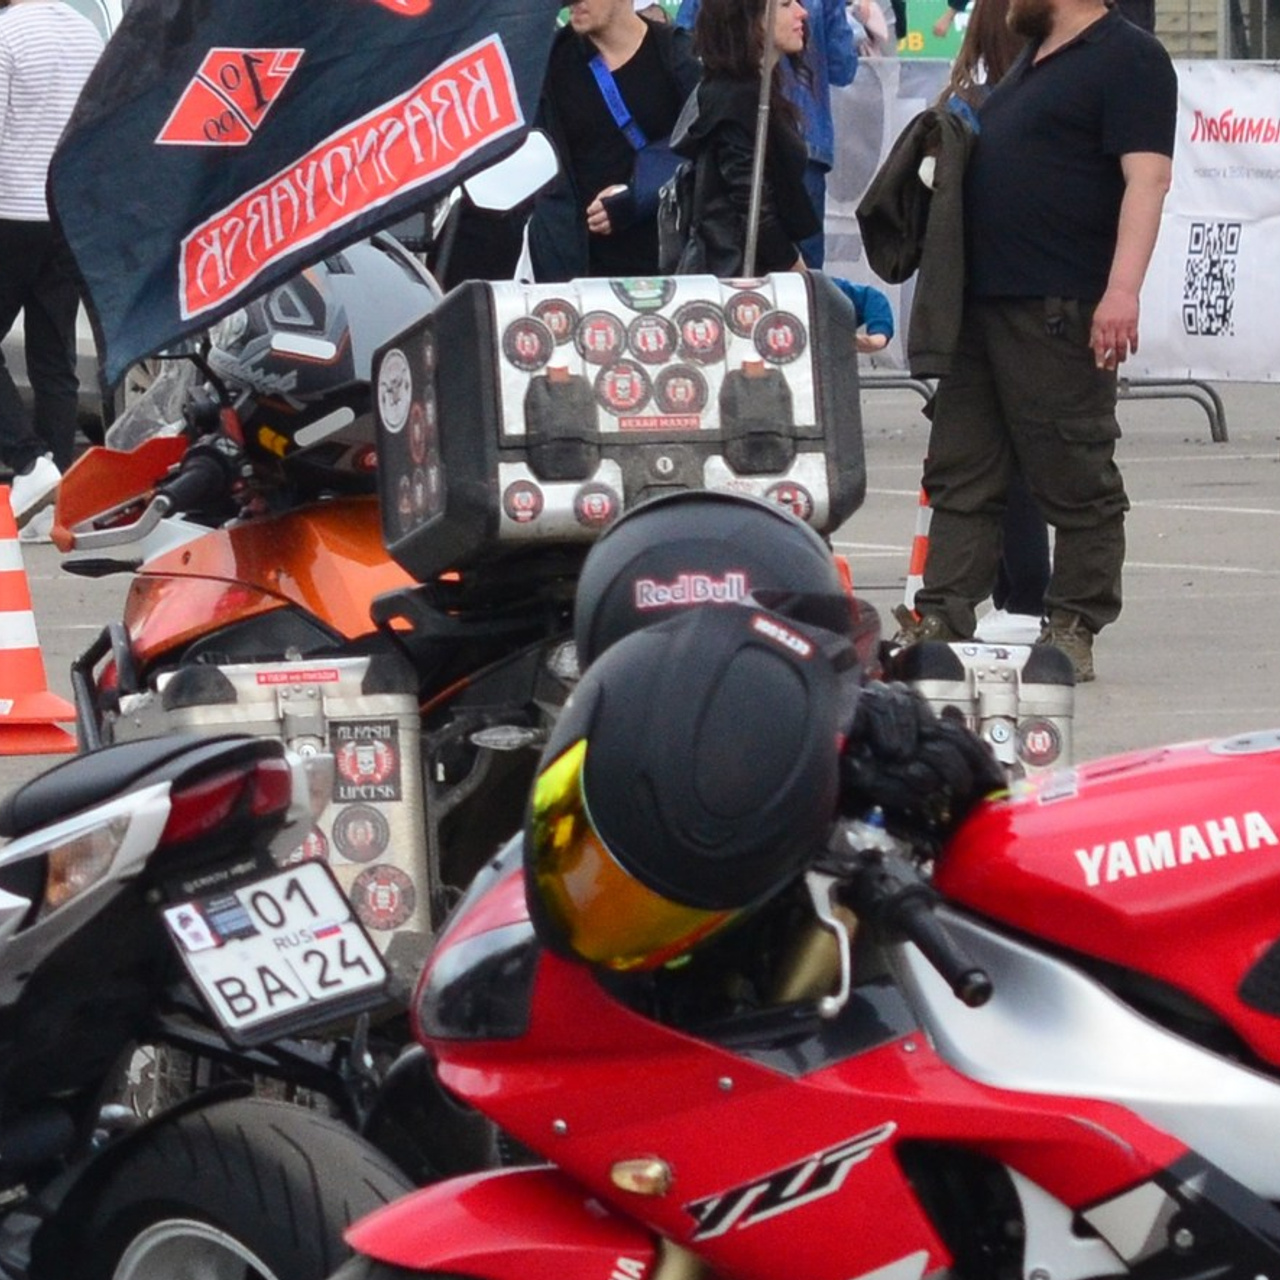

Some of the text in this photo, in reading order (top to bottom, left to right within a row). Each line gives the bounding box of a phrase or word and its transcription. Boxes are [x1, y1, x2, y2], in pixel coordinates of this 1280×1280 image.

[637, 573, 745, 606] Red Bull
[1074, 811, 1279, 887] YAMAHA
[273, 930, 313, 951] RUS
[303, 939, 371, 988] 24
